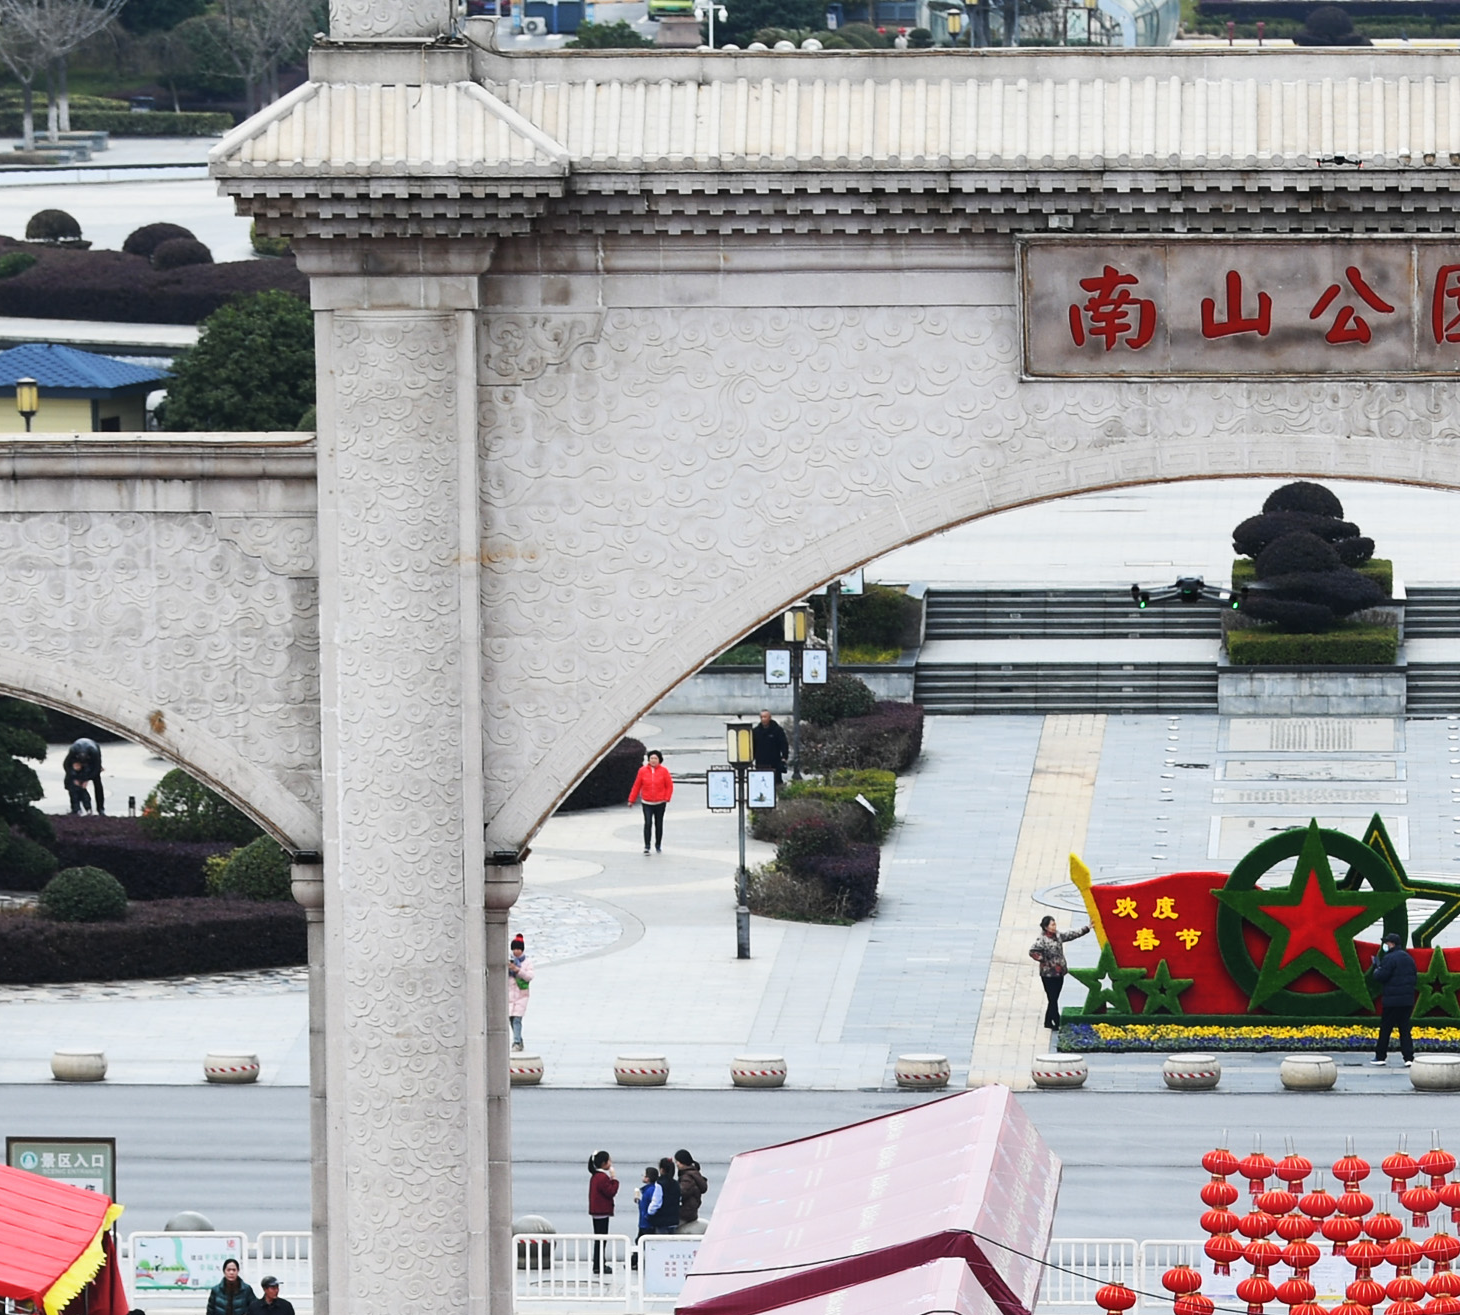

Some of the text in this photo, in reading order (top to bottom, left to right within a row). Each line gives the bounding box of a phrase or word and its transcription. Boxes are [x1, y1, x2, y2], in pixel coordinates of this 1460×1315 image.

[1112, 896, 1179, 919] 欢度
[1132, 928, 1201, 951] 春节
[41, 1152, 105, 1168] 景区入口
